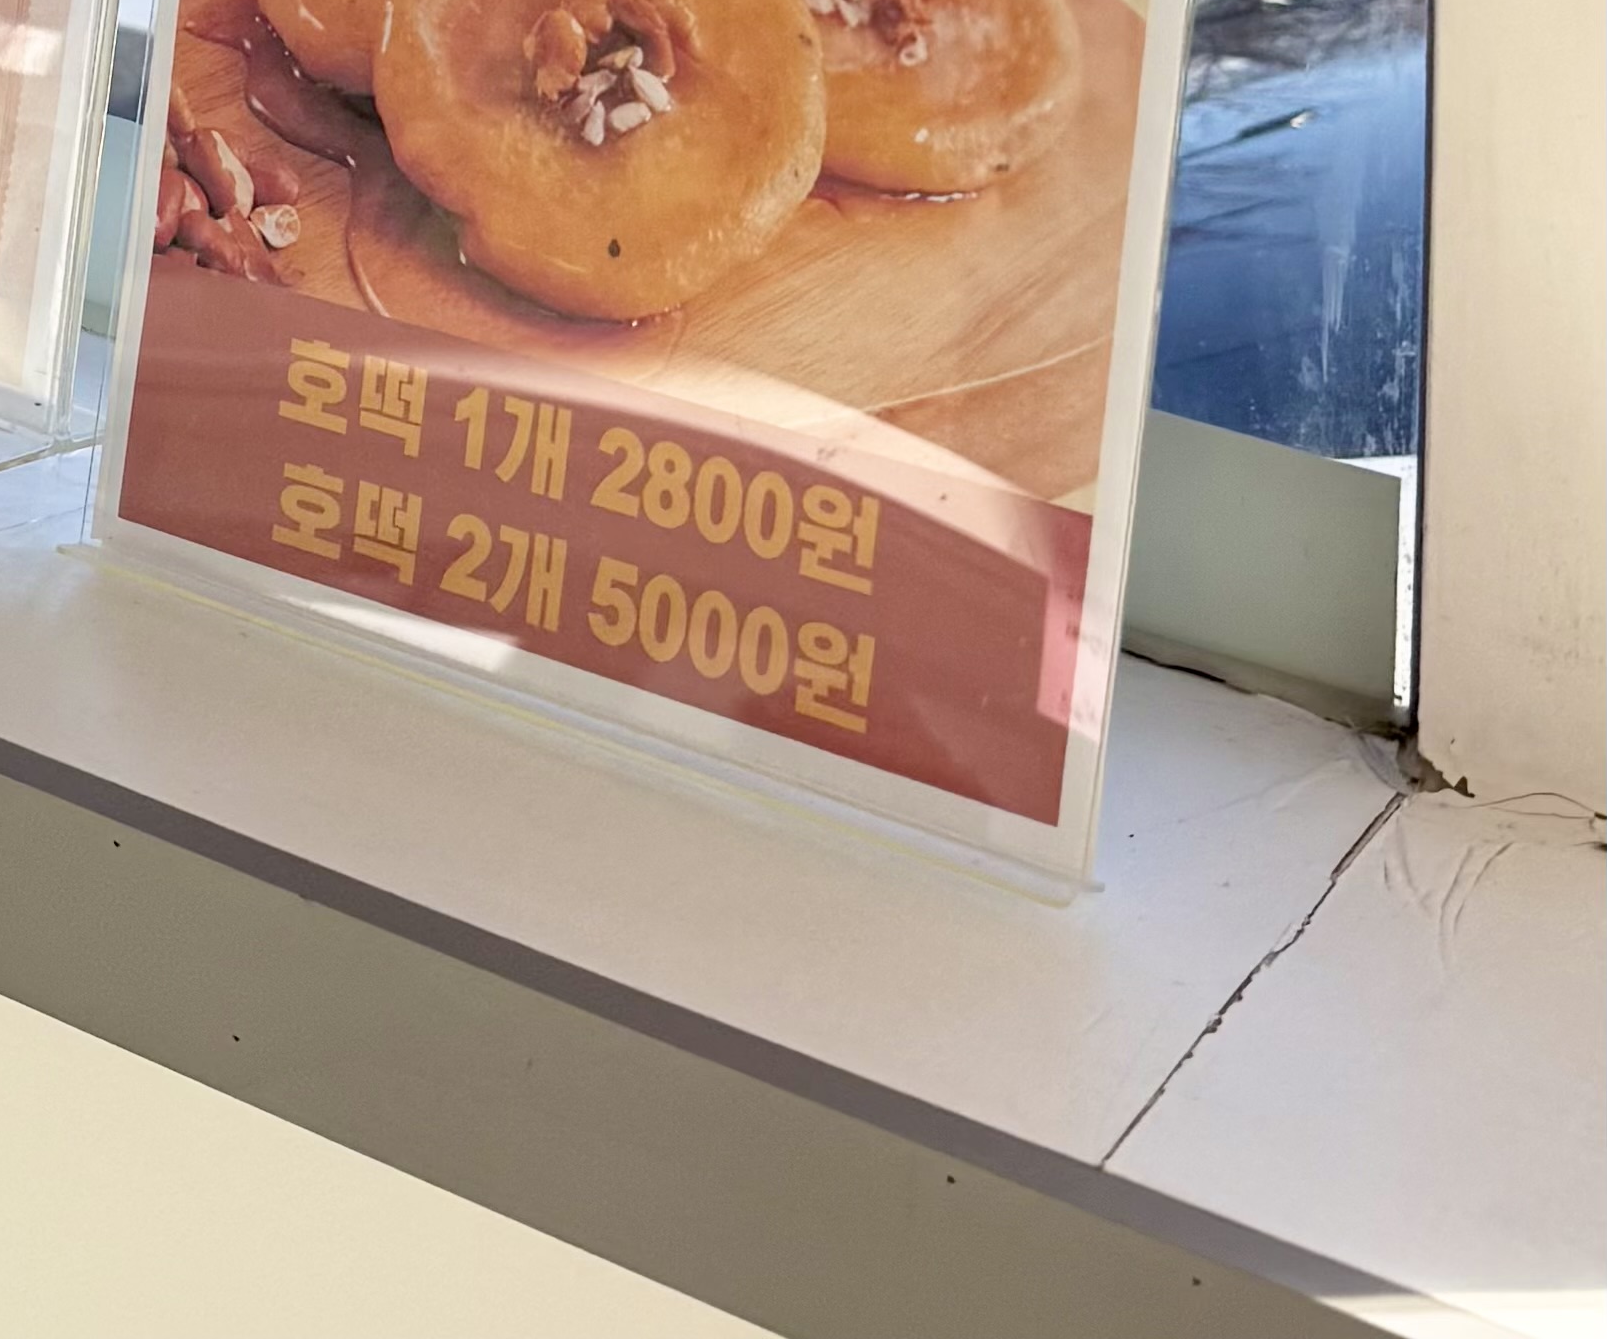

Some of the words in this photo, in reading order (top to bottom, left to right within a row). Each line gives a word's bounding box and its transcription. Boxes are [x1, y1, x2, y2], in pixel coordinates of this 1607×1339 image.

[270, 460, 425, 588] 호떡
[439, 511, 570, 634] 2개
[586, 556, 877, 735] 5000원
[278, 337, 430, 459] 호떡
[452, 386, 573, 503] 1개
[588, 425, 882, 596] 2800원
